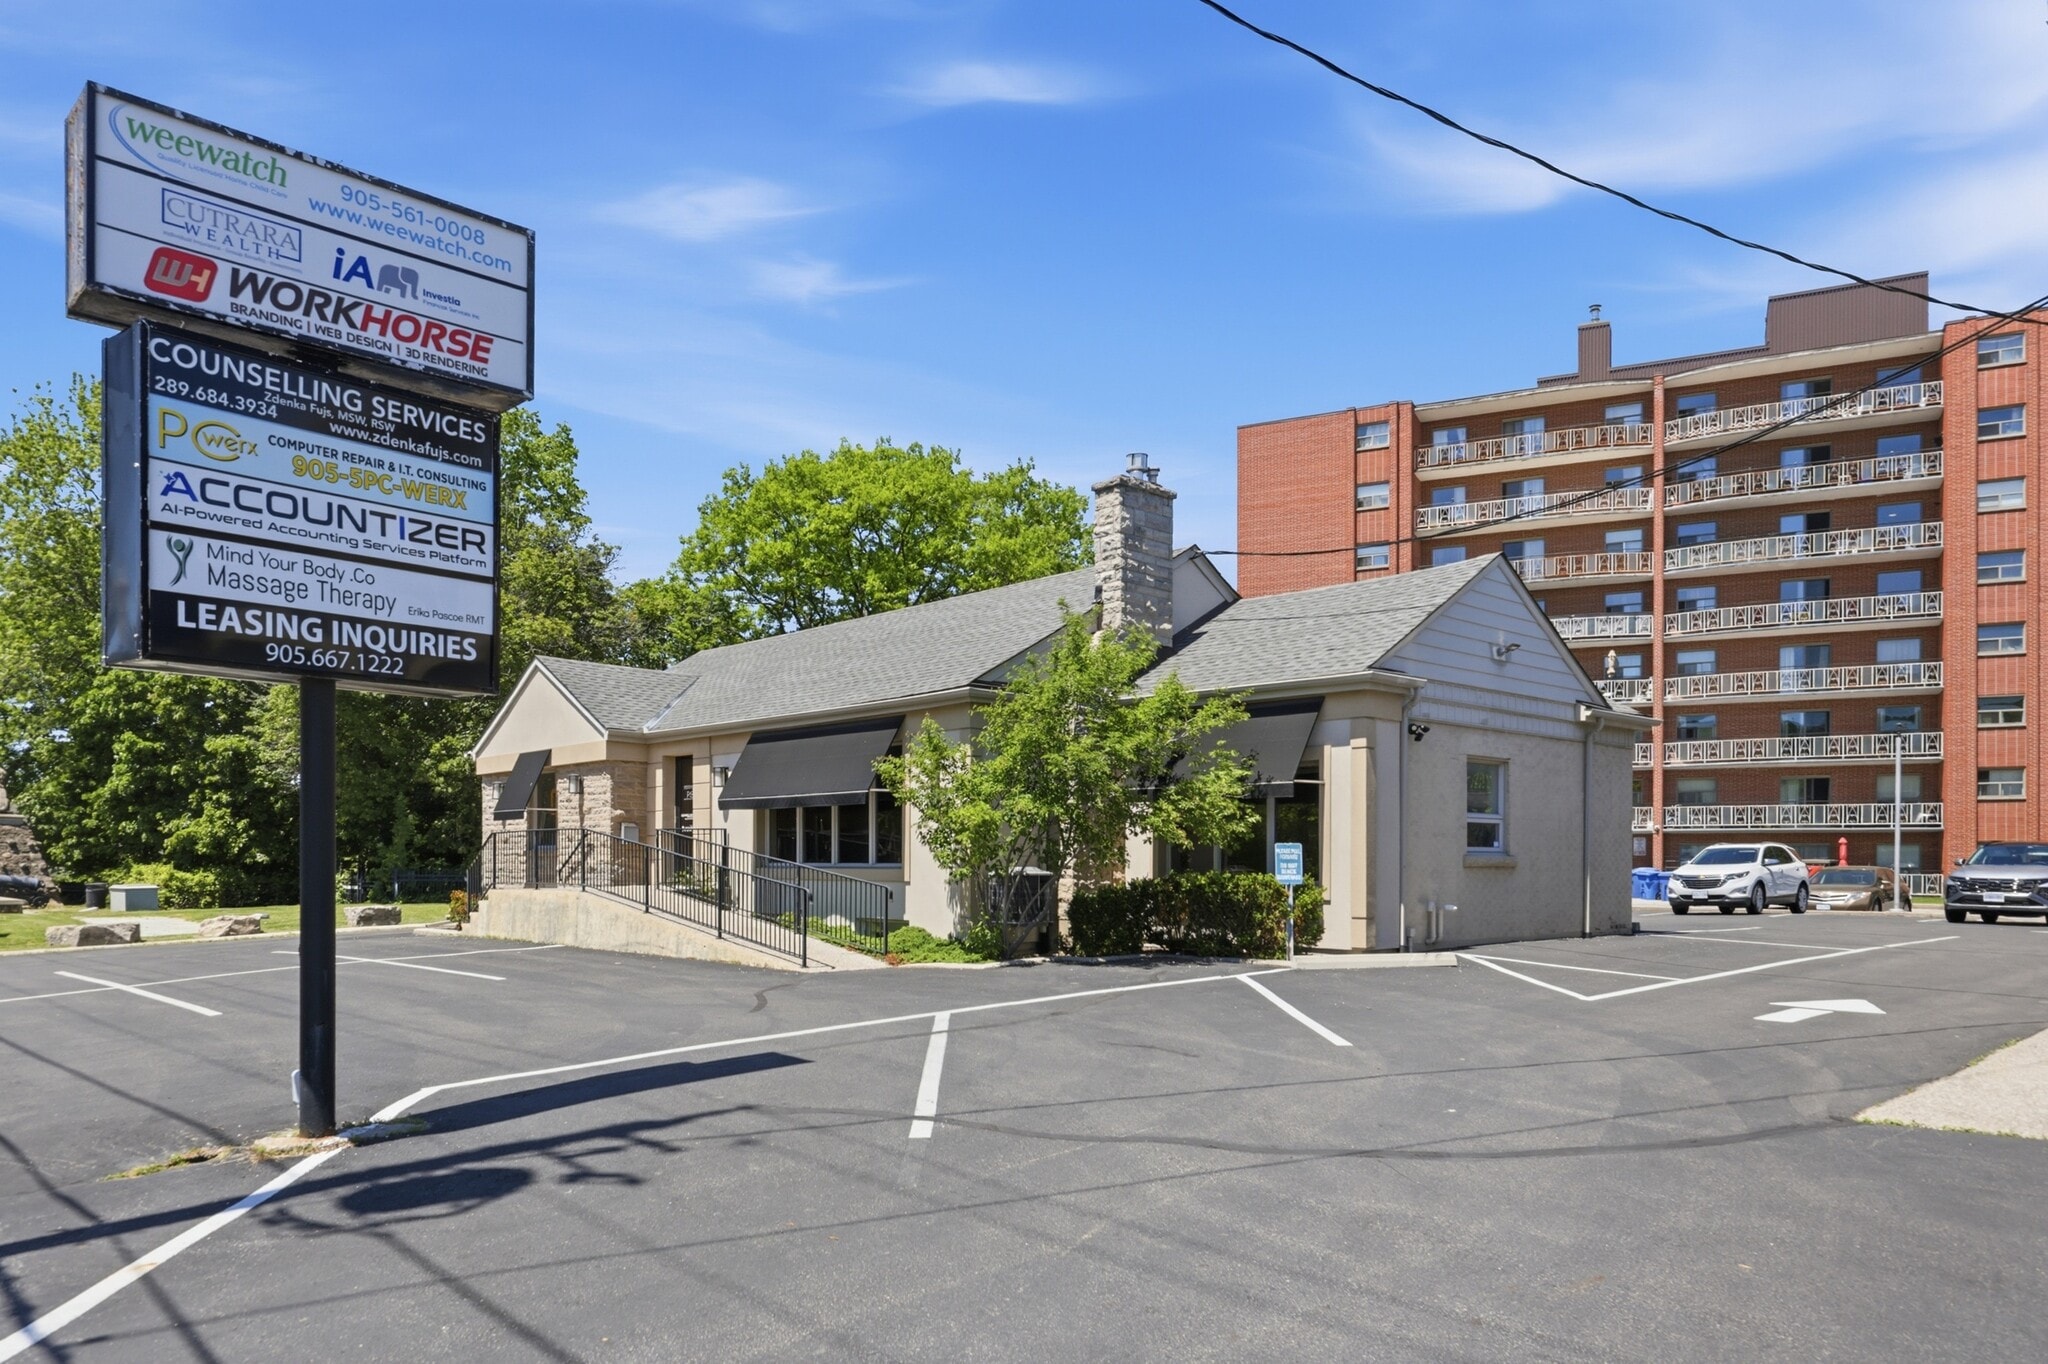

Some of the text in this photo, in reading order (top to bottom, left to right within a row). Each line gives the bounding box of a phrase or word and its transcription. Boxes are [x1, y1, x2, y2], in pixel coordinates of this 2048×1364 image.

[126, 117, 287, 188] weewatch
[166, 197, 298, 252] CUTRARA
[184, 221, 281, 260] WEALTH
[308, 198, 512, 273] www.weewatch.com
[340, 184, 486, 246] 905-561-0008
[229, 267, 495, 365] WORKHORSE
[422, 288, 461, 307] Investia
[230, 302, 303, 330] BRANDING
[314, 323, 343, 340] WEB
[346, 331, 393, 353] DESIGN
[405, 347, 421, 360] 3D
[422, 351, 489, 378] RENDERING
[149, 337, 486, 444] COUNSELLING SERVICES
[154, 375, 278, 419] 289.684.3934
[263, 391, 396, 433] Zdenka Fujs, MSW, RSW
[267, 434, 487, 492] COMPUTER REPAIR & I.T. CONSULTING
[329, 422, 483, 468] www.zdenkafujs.com
[292, 454, 468, 511] 905-5PC-WERX
[160, 471, 487, 555] ACCOUNTIZER
[160, 503, 487, 568] AI-Powered Accounting Services Platform
[207, 542, 376, 586] Mind Your Body .Co
[208, 563, 397, 617] Massage Therapy
[177, 599, 478, 662] LEASING INQUIRIES
[408, 606, 486, 626] Erika Pascoe RMT
[265, 642, 405, 676] 905.667.1222
